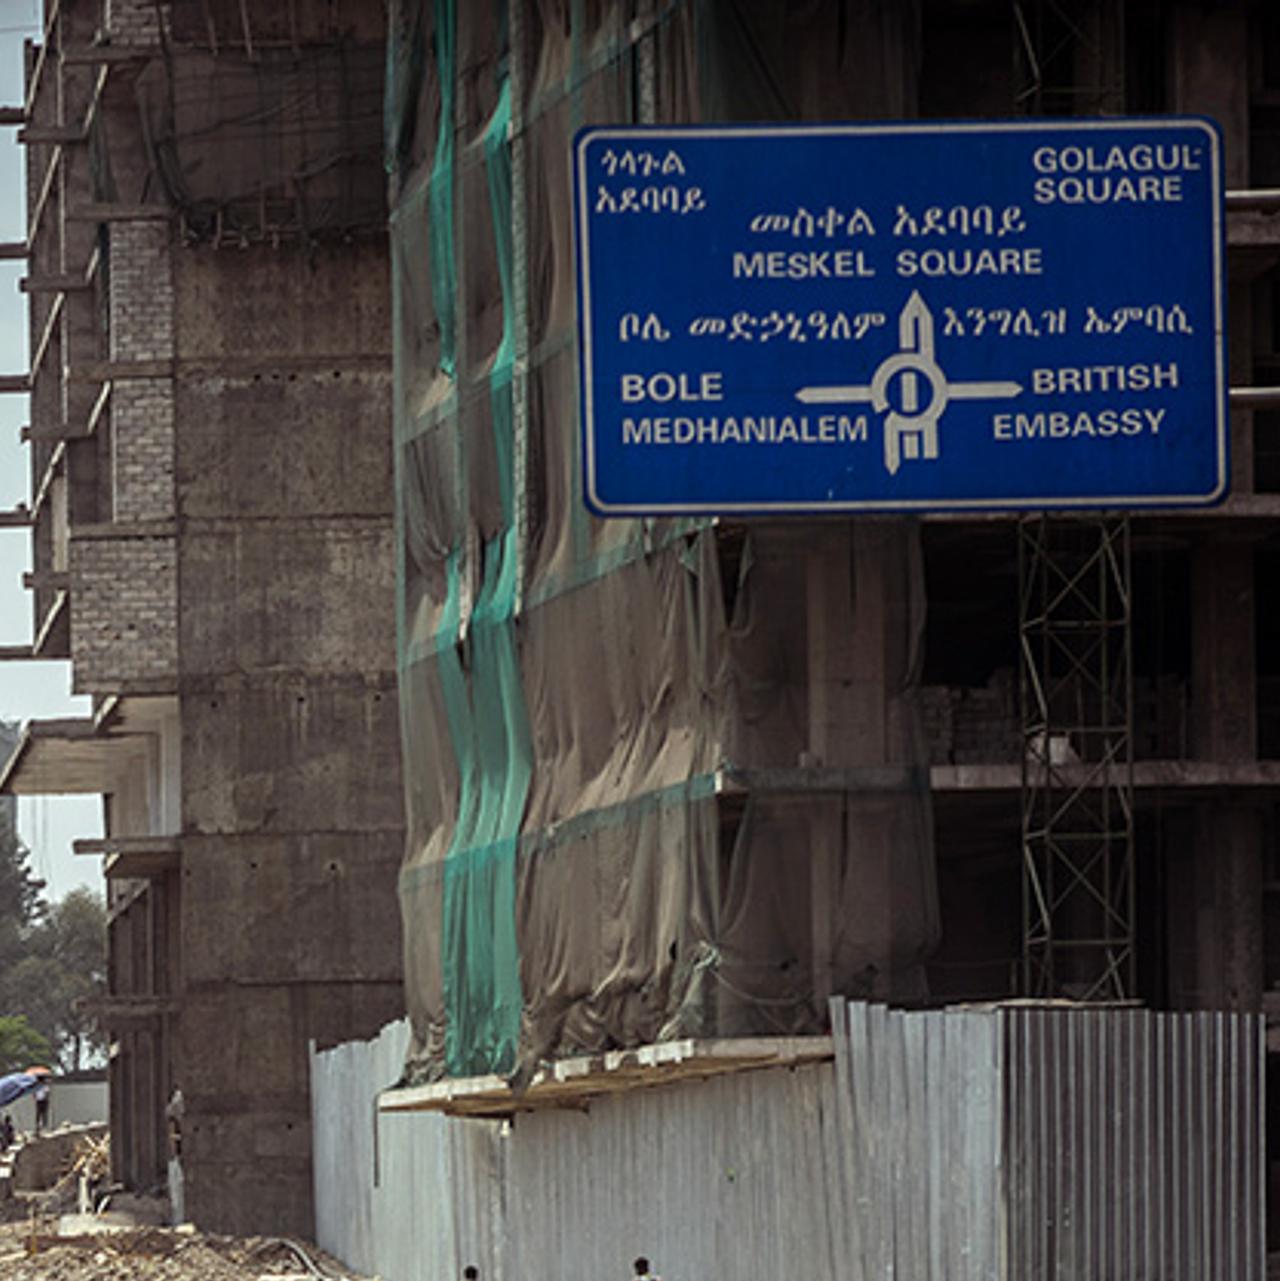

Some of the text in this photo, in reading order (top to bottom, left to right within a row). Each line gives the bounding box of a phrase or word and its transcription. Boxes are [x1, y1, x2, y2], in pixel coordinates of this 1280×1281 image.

[1033, 145, 1199, 173] GOLAGUL
[595, 186, 705, 214] አደባባይ
[1034, 176, 1181, 203] SQUARE
[750, 205, 1026, 237] መስቀል አደባባይ
[733, 249, 1042, 278] MESKEL SQUARE
[619, 313, 670, 342] ቦሌ
[621, 373, 723, 402] BOLE
[1033, 363, 1178, 394] BRITISH
[622, 415, 868, 444] MEDHANIALEM
[993, 409, 1165, 440] EMBASSY
